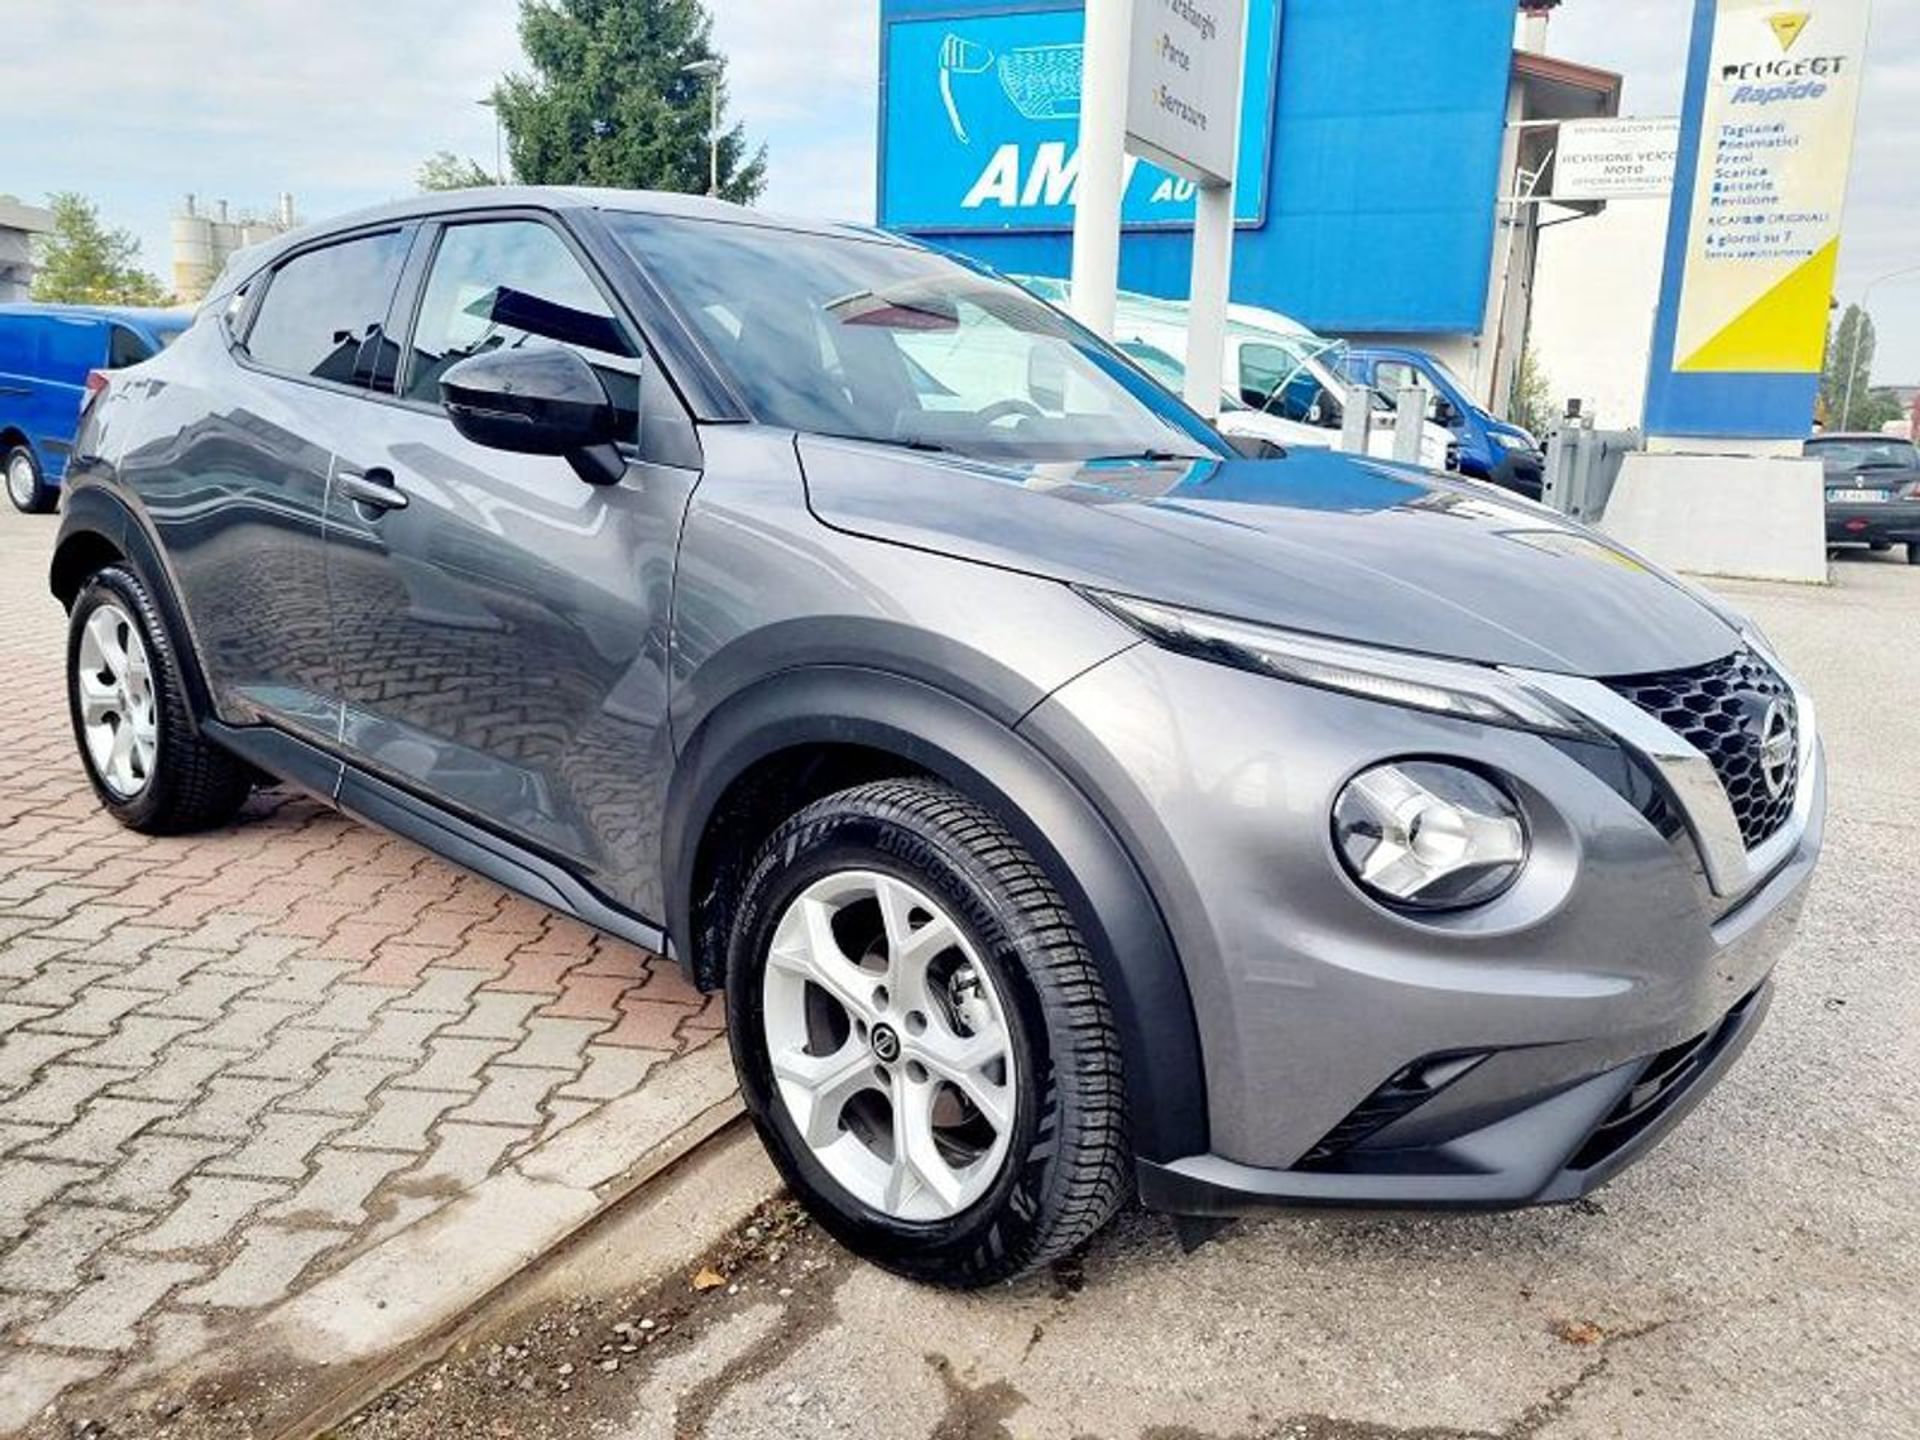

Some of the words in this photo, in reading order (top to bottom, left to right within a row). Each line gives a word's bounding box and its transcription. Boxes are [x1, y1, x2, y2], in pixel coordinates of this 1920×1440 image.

[1730, 81, 1828, 106] Rapide
[1719, 136, 1799, 149] Pneumatici
[1716, 153, 1753, 164] Freni
[1149, 178, 1198, 205] AU
[1713, 181, 1773, 193] Batterie
[1711, 195, 1779, 207] Revisione
[1718, 232, 1760, 248] giorni
[1784, 230, 1792, 243] 7
